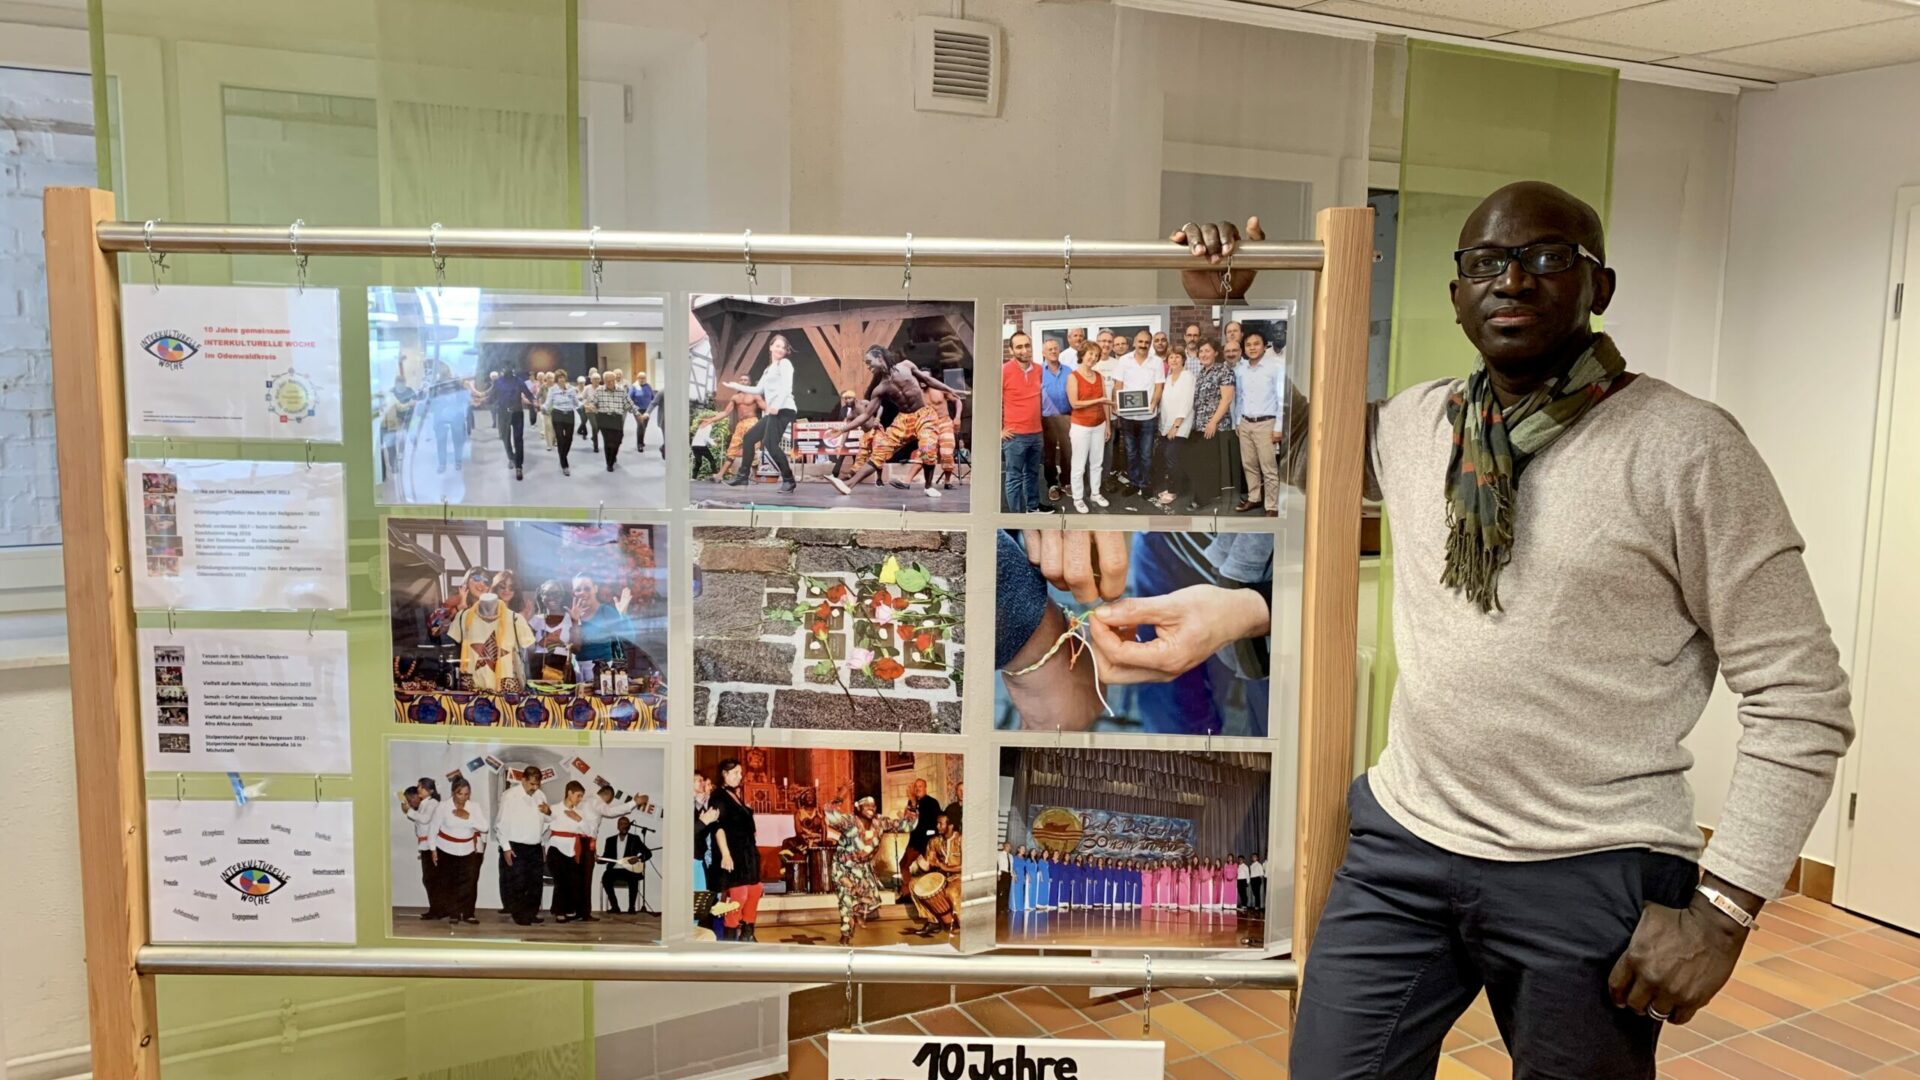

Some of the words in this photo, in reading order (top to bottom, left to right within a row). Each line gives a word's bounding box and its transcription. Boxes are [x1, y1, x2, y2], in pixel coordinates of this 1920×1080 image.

[140, 330, 202, 349] INTERKULTURELLE
[158, 361, 184, 370] WOCHE
[220, 859, 291, 882] INTERKULTURELLE
[241, 893, 270, 906] WOCHE
[912, 1042, 965, 1080] 10
[966, 1043, 1078, 1080] Jahre
